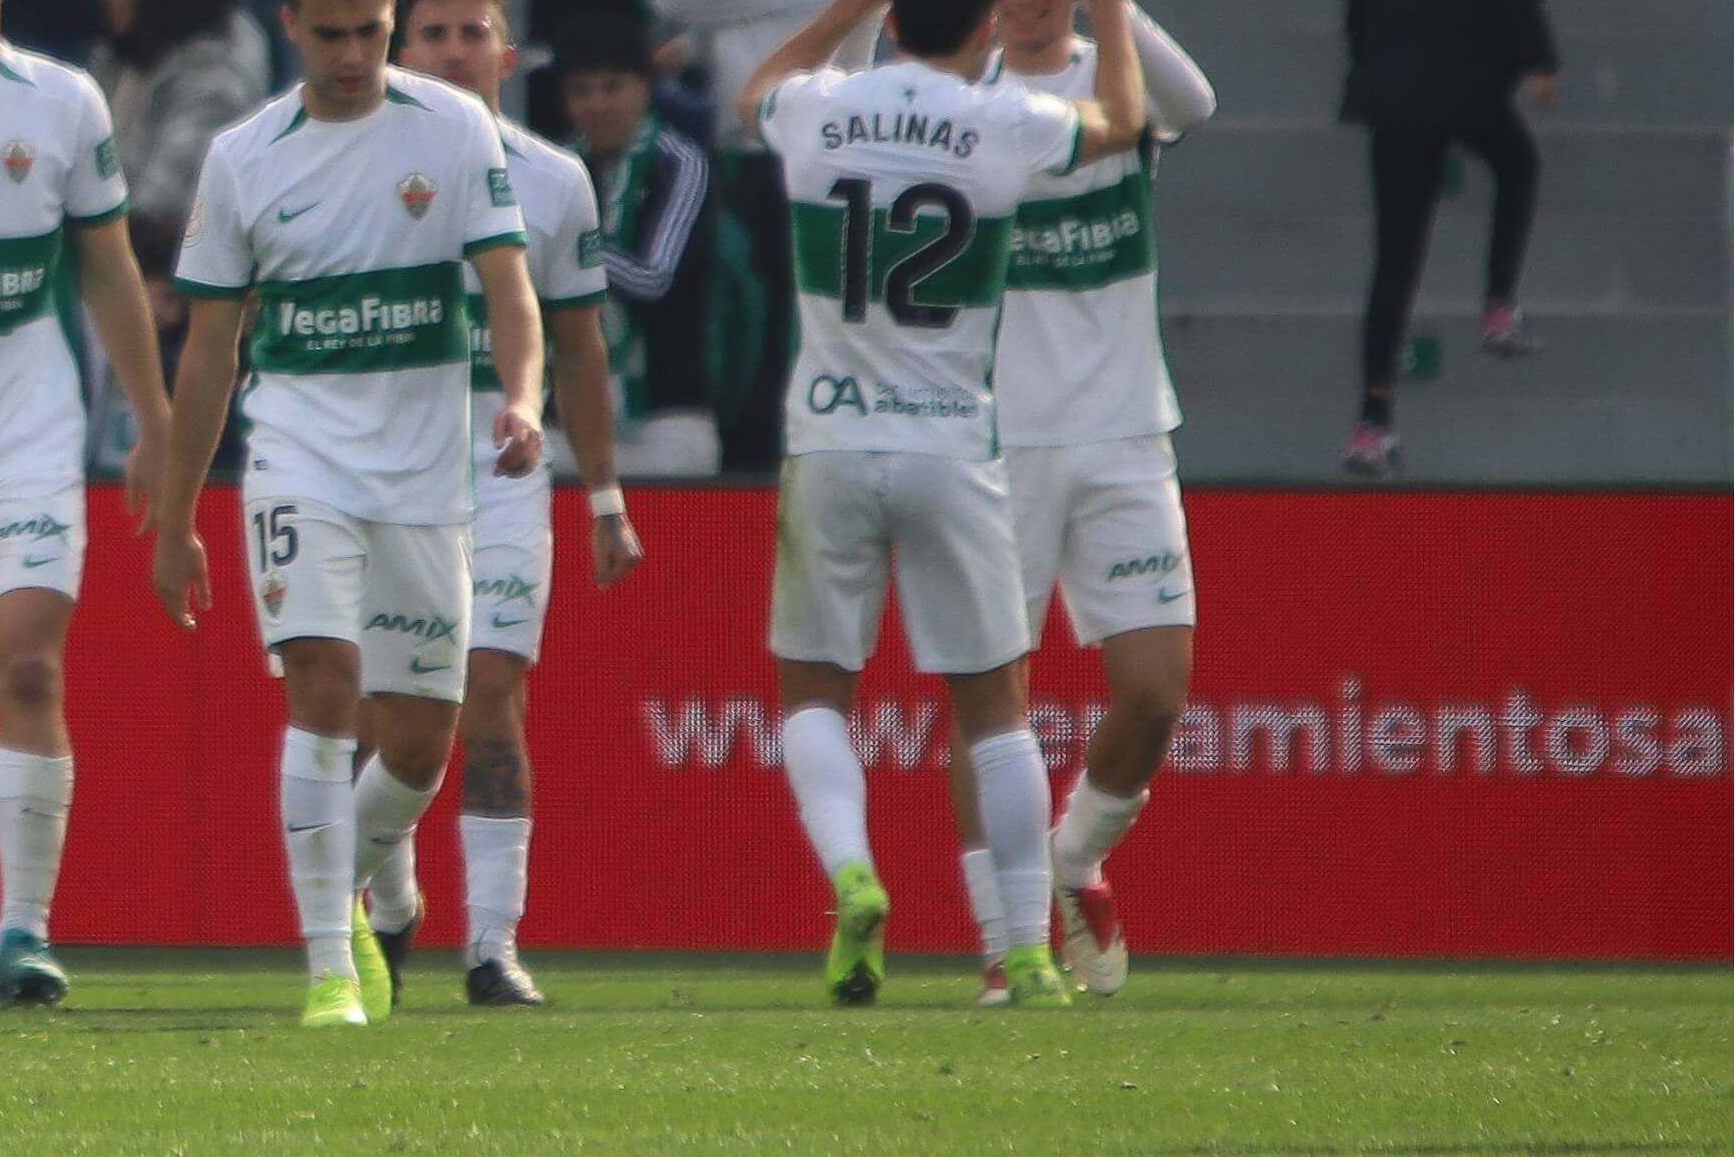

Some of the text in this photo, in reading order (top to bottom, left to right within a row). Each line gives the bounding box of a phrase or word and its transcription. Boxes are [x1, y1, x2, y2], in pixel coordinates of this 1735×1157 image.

[821, 112, 981, 158] SALINAS
[827, 178, 977, 330] 12
[252, 504, 299, 573] 15
[363, 609, 458, 647] AMIX
